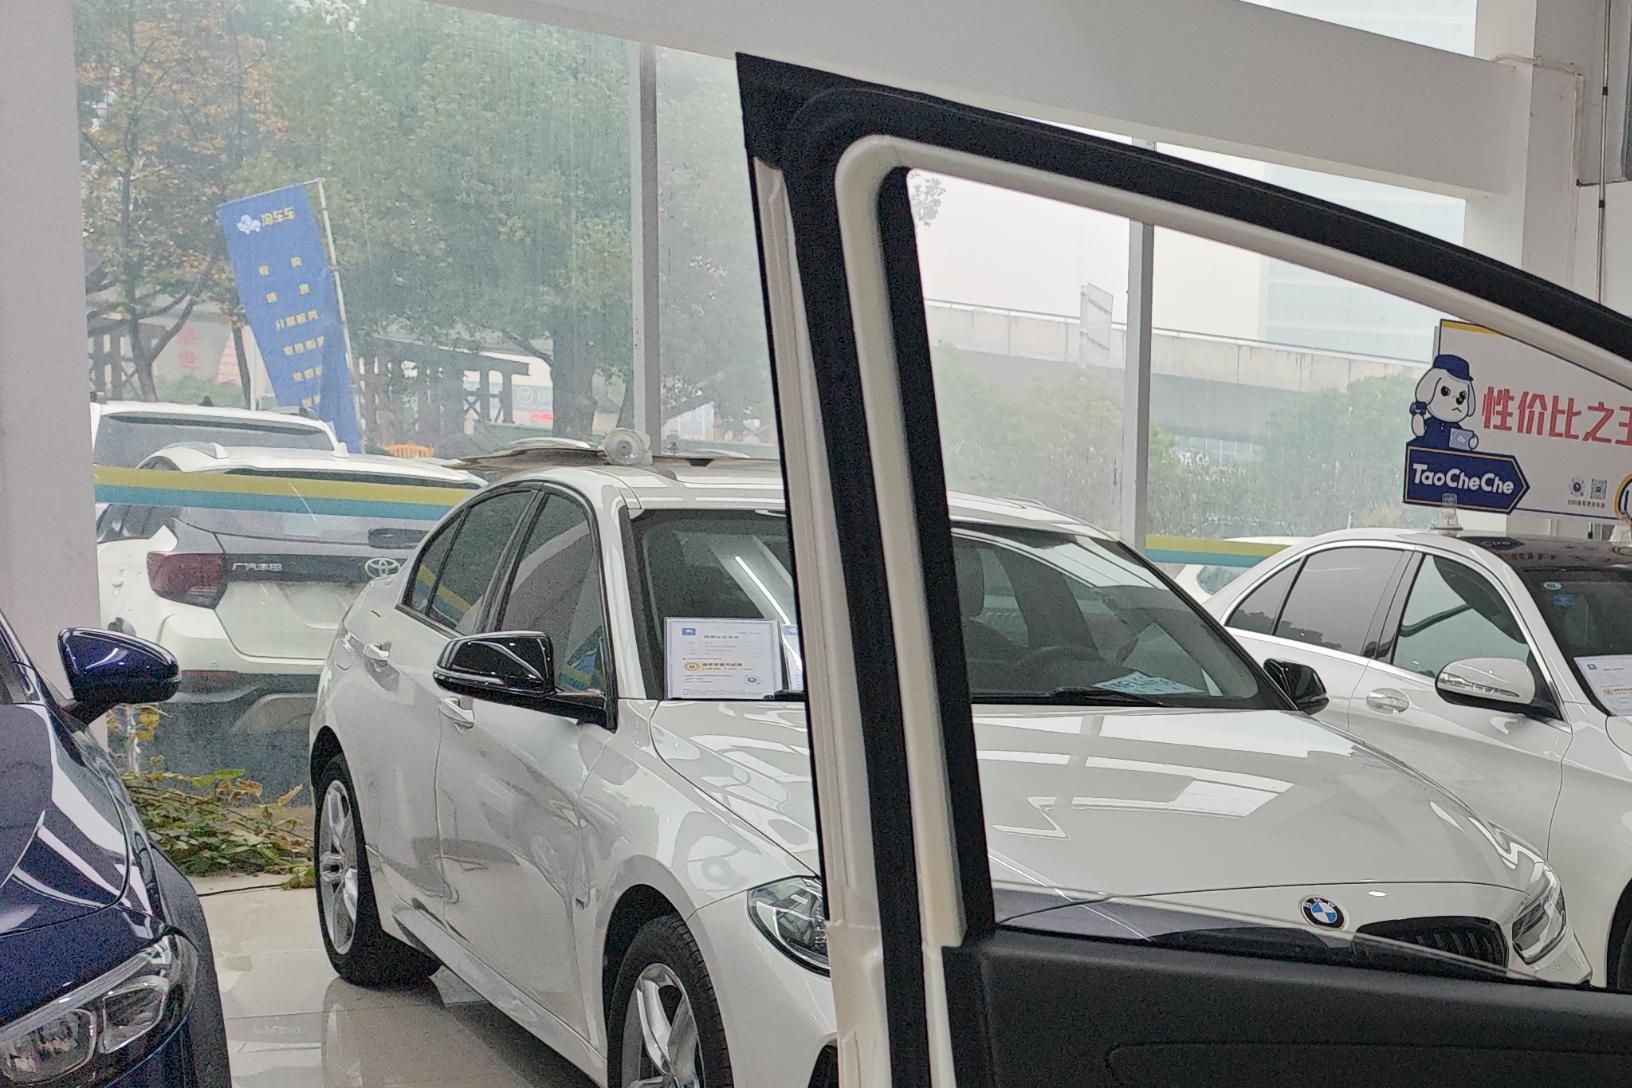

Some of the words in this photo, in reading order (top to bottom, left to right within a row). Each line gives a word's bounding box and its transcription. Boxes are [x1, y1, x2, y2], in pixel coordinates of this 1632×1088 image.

[1412, 463, 1515, 495] TaoCheChe
[231, 562, 283, 572] 广汽丰田
